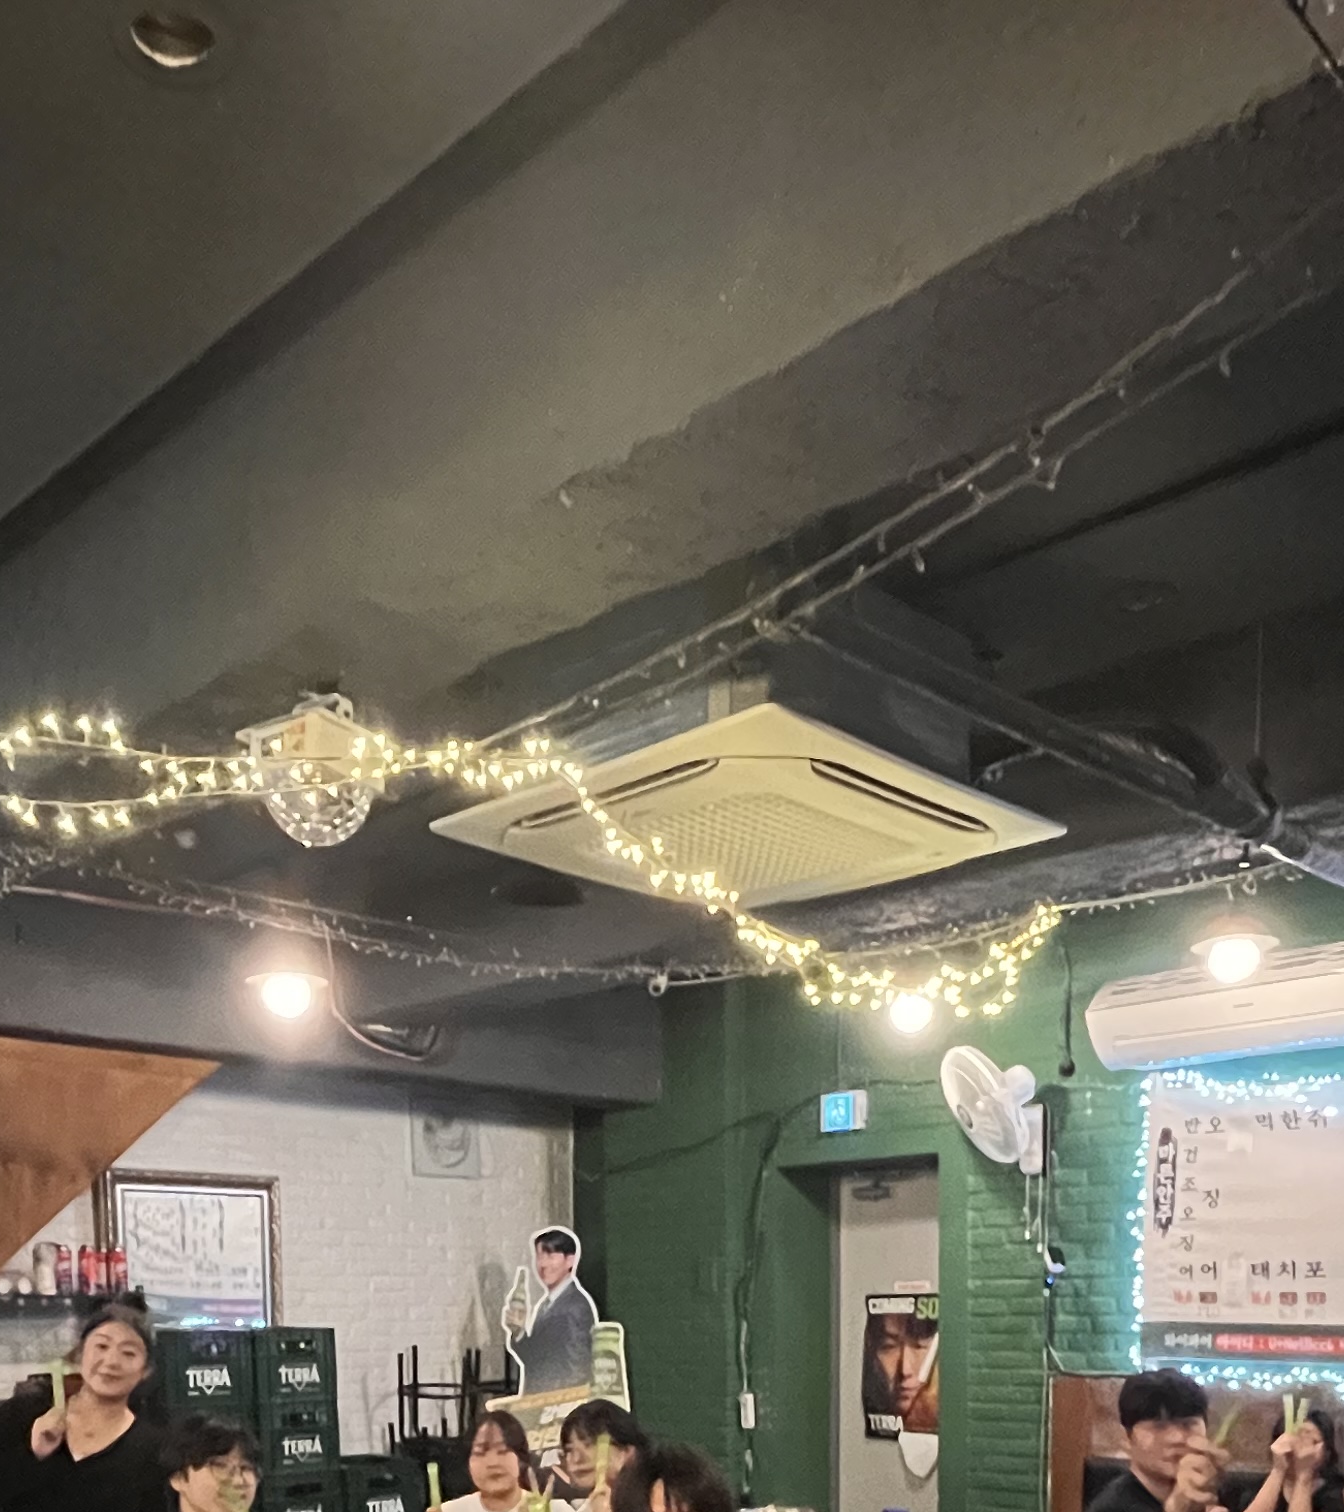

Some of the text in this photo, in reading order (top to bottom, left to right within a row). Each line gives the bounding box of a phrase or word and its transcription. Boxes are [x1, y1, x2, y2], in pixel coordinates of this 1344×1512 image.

[186, 1364, 232, 1389] TERRA
[278, 1363, 321, 1385] TERRA
[282, 1434, 323, 1455] TERRA
